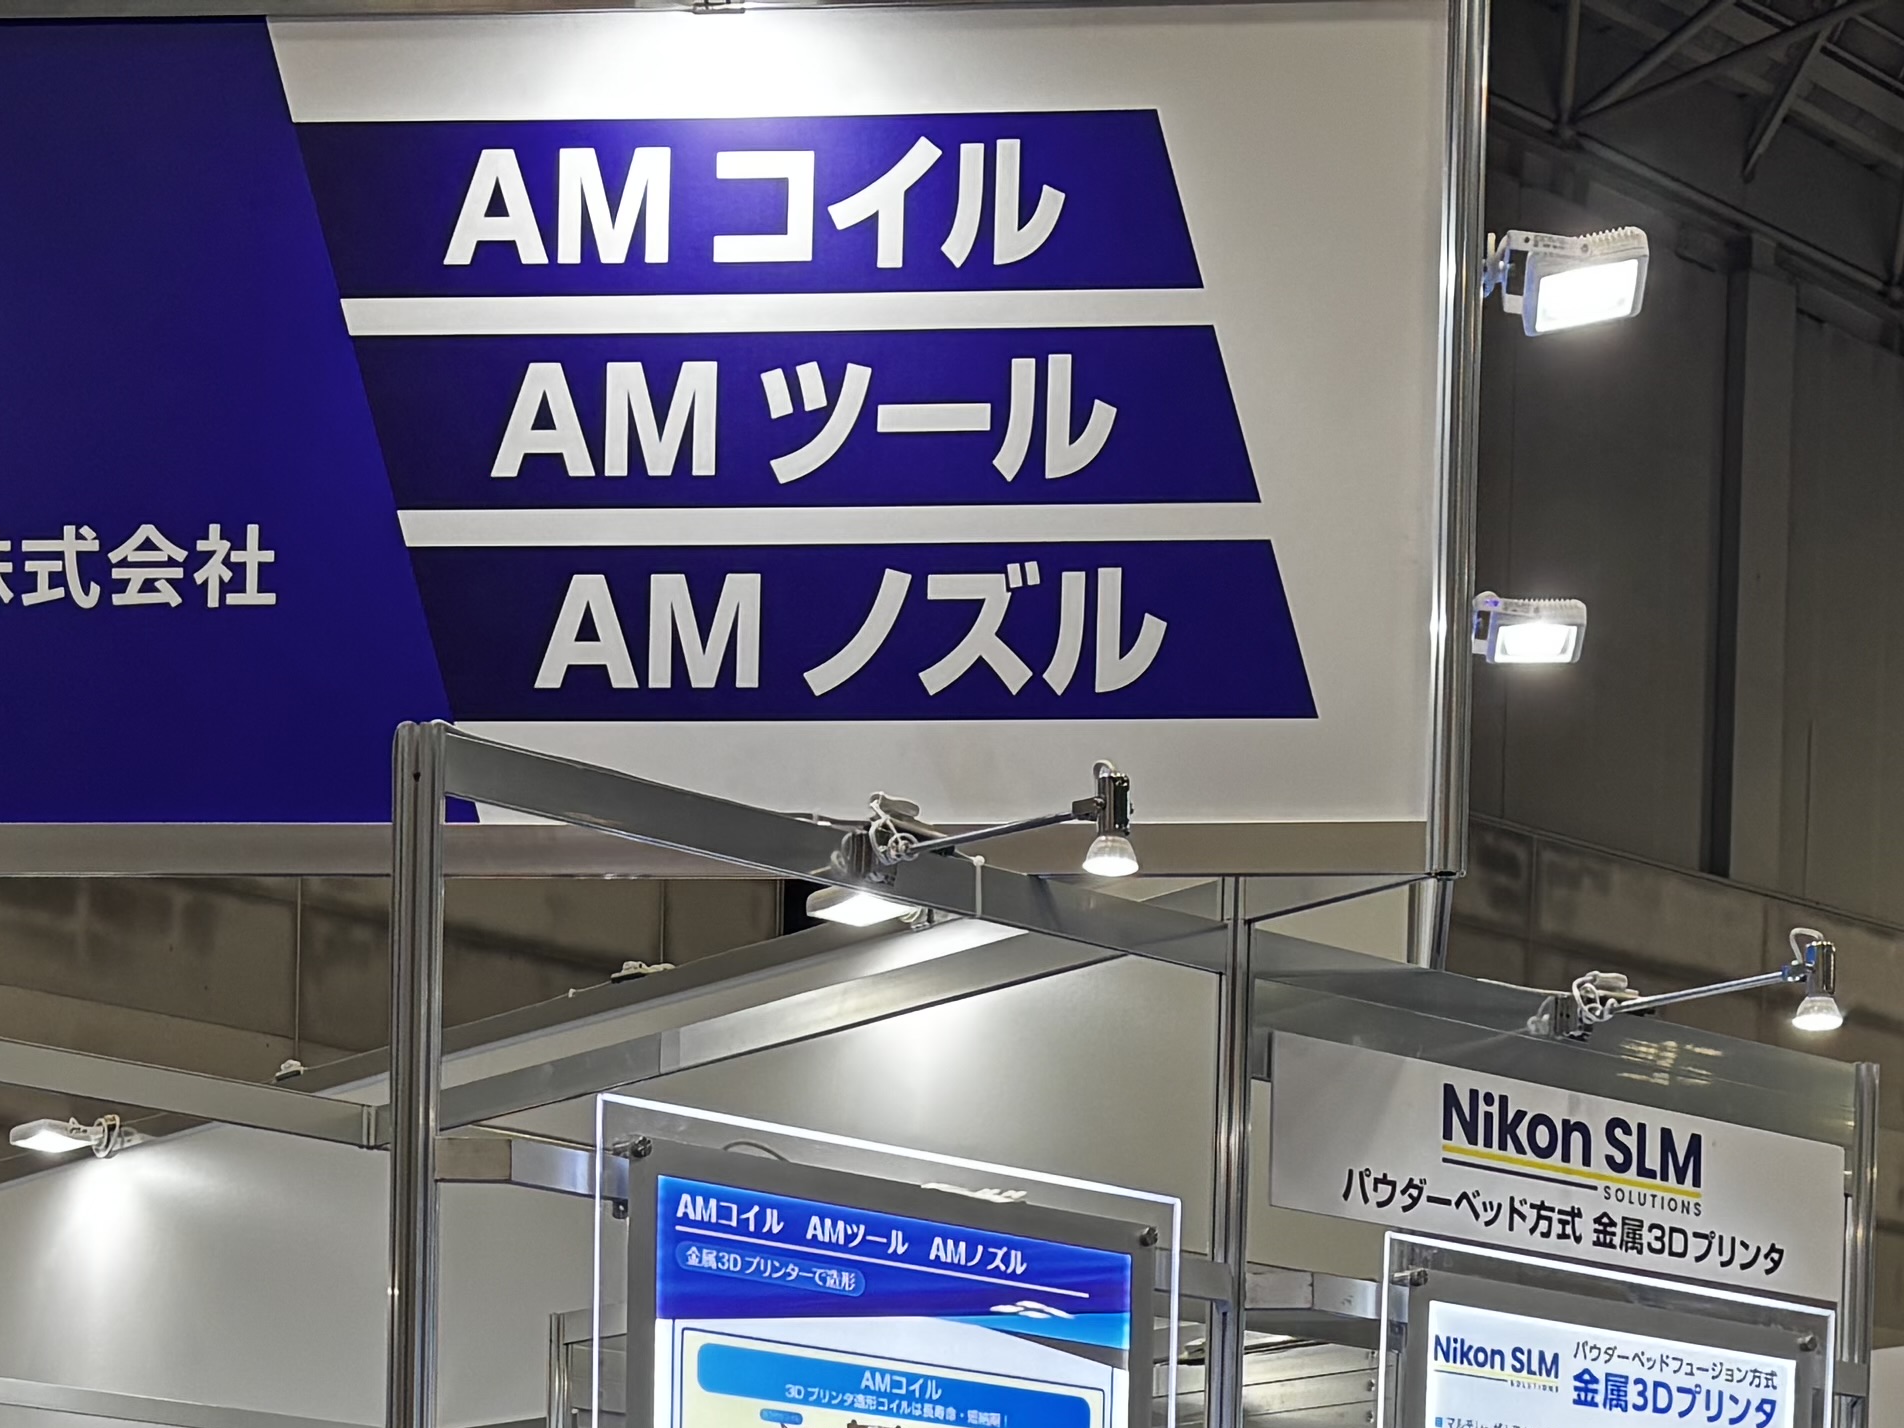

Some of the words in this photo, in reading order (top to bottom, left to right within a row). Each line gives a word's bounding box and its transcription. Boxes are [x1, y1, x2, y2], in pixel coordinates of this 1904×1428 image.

[444, 149, 669, 269] AM
[709, 138, 1065, 271] コイル
[490, 361, 722, 479] AM
[759, 350, 1118, 488] ツール
[536, 573, 759, 691] AM
[798, 562, 1168, 698] ノズル
[1441, 1082, 1592, 1168] Nikon
[1604, 1117, 1703, 1189] SLM
[677, 1193, 784, 1235] AMコイル
[806, 1215, 908, 1255] AMツール
[929, 1237, 1027, 1275] AMノズル
[1342, 1167, 1583, 1244] パウダーベッド方式
[1592, 1211, 1785, 1277] 金属3Dプリンタ
[1603, 1186, 1703, 1217] SOLUTIONS
[860, 1370, 942, 1400] AMコイル
[1434, 1334, 1505, 1373] Nikon
[1511, 1346, 1559, 1380] SLM
